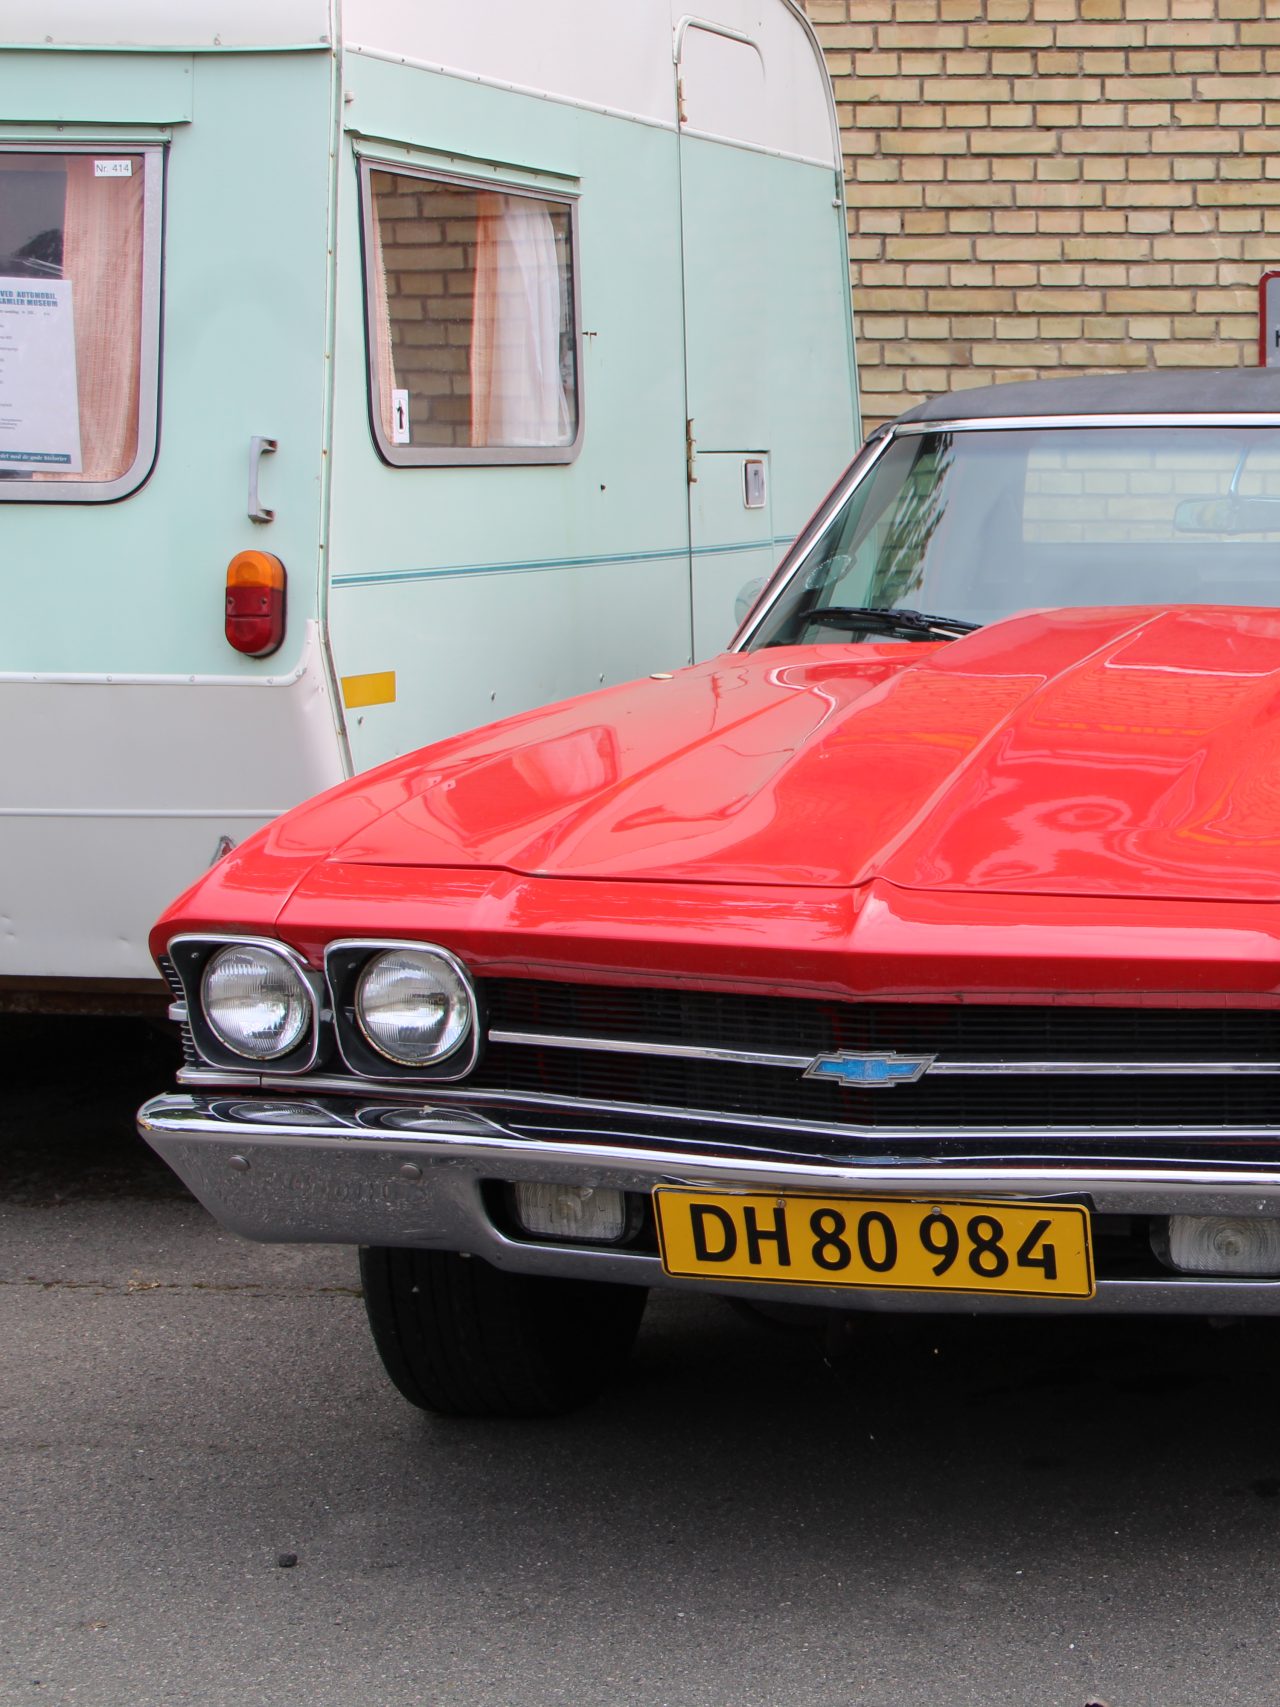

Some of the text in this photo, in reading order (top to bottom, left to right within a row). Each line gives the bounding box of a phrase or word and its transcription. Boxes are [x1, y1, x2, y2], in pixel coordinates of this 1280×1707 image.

[112, 163, 129, 173] 414
[16, 290, 56, 300] AUTOMOBIL
[27, 299, 58, 307] MUSEUM
[689, 1203, 1058, 1280] DH 80 984
